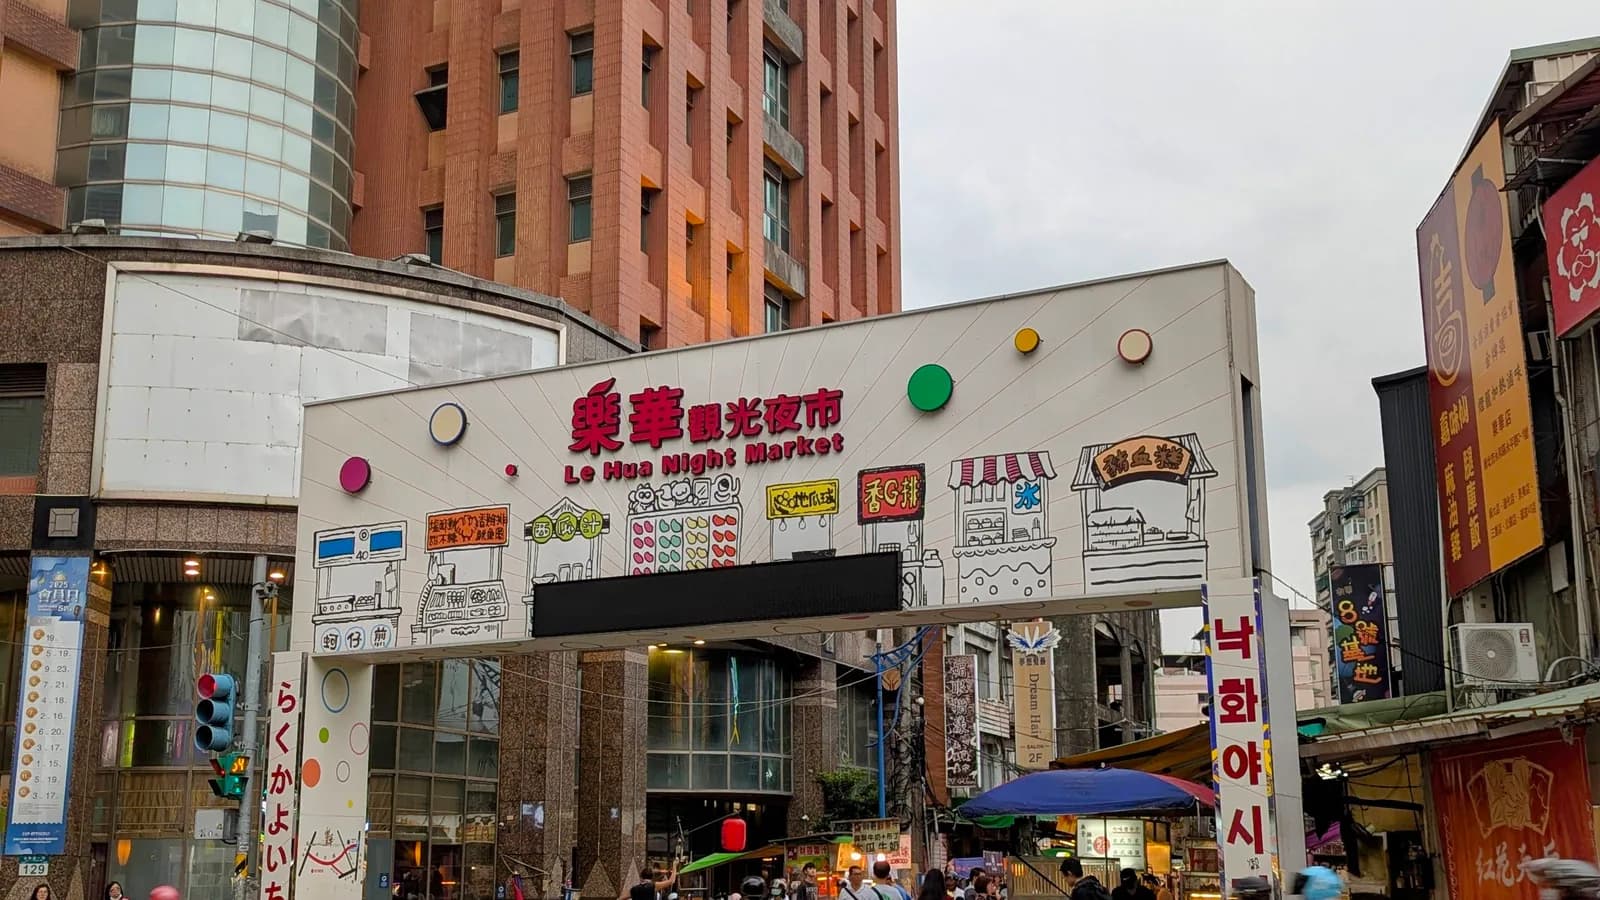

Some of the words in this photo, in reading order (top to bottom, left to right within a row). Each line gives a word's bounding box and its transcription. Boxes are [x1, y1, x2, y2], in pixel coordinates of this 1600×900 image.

[564, 463, 595, 485] Le
[603, 459, 653, 481] Hua
[661, 447, 737, 475] Night
[744, 432, 845, 465] Market
[793, 487, 836, 508] 地瓜球
[864, 475, 919, 514] 香G排
[534, 512, 601, 539] 西瓜汁
[355, 550, 369, 561] 40
[323, 627, 388, 650] 蚵仔煎
[1028, 673, 1040, 711] Dream
[1030, 714, 1041, 739] Hair
[1028, 752, 1043, 763] 2F
[1214, 615, 1267, 889] 낙화야시
[264, 681, 297, 900] らくかよいち
[23, 864, 46, 875] 129
